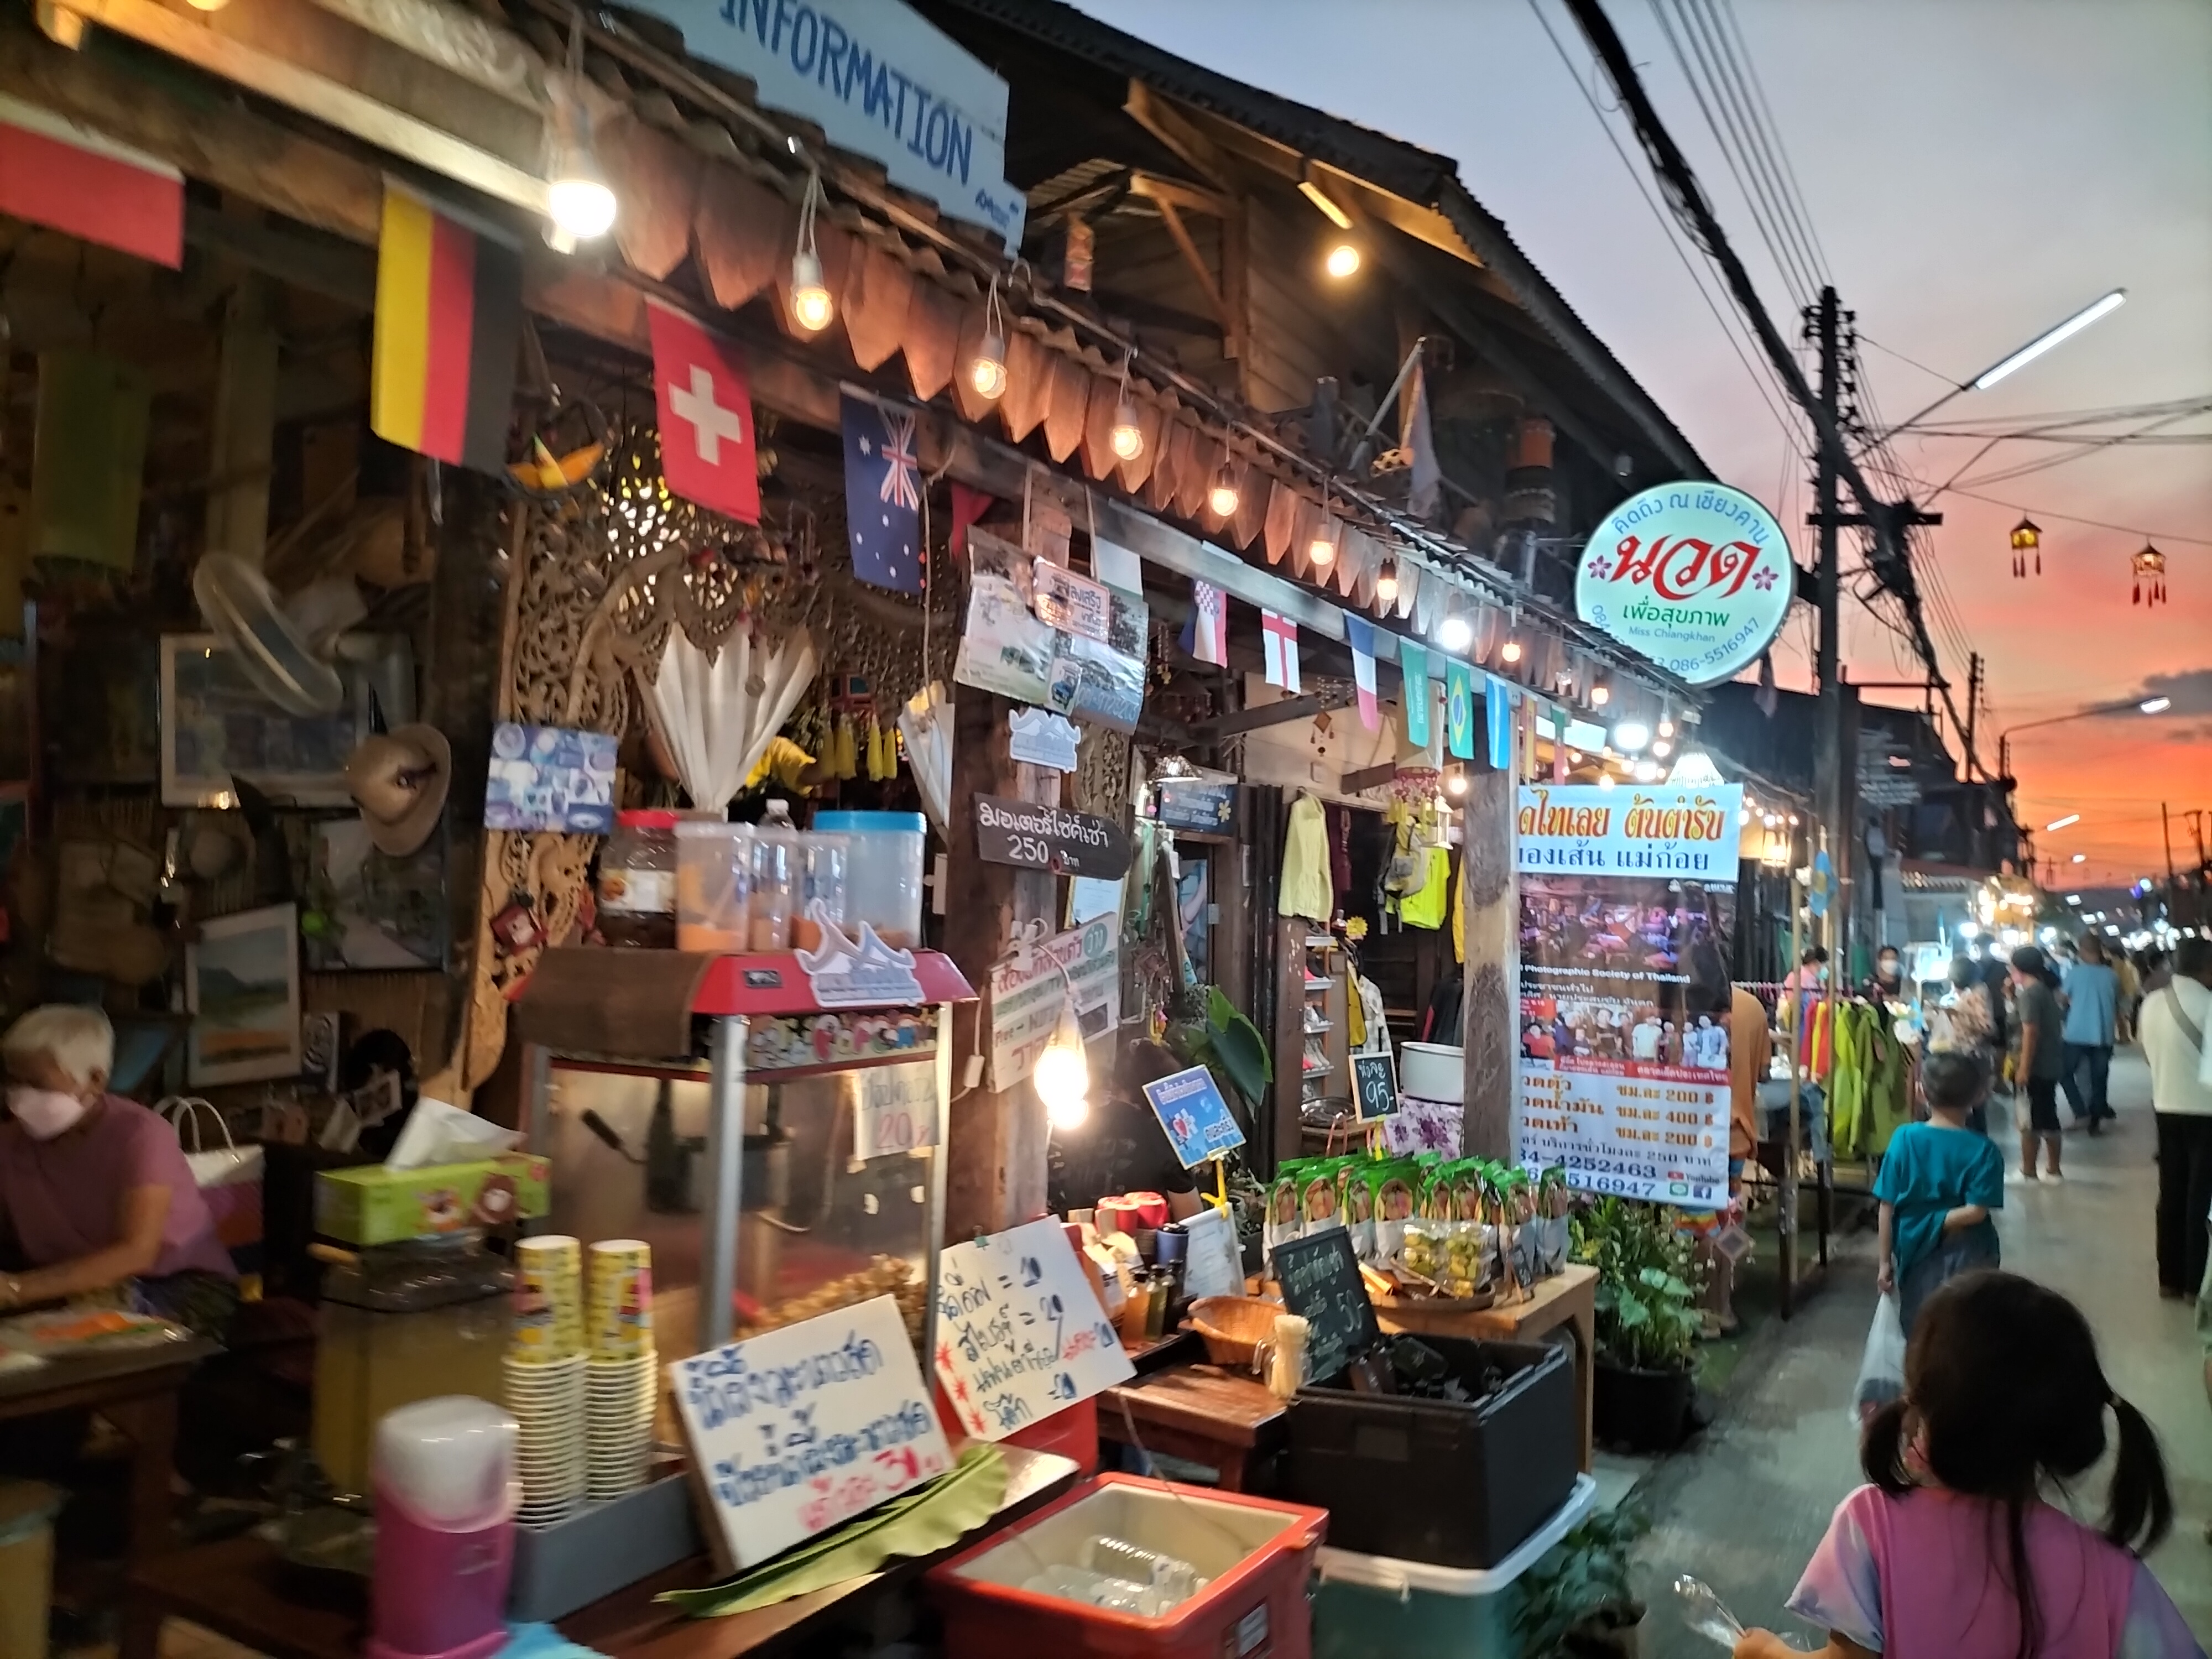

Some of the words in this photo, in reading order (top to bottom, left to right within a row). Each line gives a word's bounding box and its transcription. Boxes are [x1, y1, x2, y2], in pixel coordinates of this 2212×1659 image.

[1611, 498, 1662, 534] คิดถึง
[1670, 493, 1688, 508] ณ
[1696, 490, 1771, 545] เชียงคาน
[1608, 534, 1762, 601] นวด
[1623, 596, 1730, 629] เพื่อสุขภาพ
[1629, 627, 1650, 637] Miss
[1654, 628, 1715, 643] Chiangkhan
[1624, 793, 1725, 841] ต้นตำรับ
[1007, 834, 1049, 864] 250
[1618, 842, 1709, 870] แม่ก้อย
[1526, 965, 1590, 977] Photographic
[1592, 969, 1630, 980] Society
[1632, 972, 1644, 980] of
[1646, 972, 1691, 984] Thailand
[1666, 1089, 1698, 1103] 200
[1666, 1110, 1698, 1125] 400
[1665, 1132, 1697, 1146] 200
